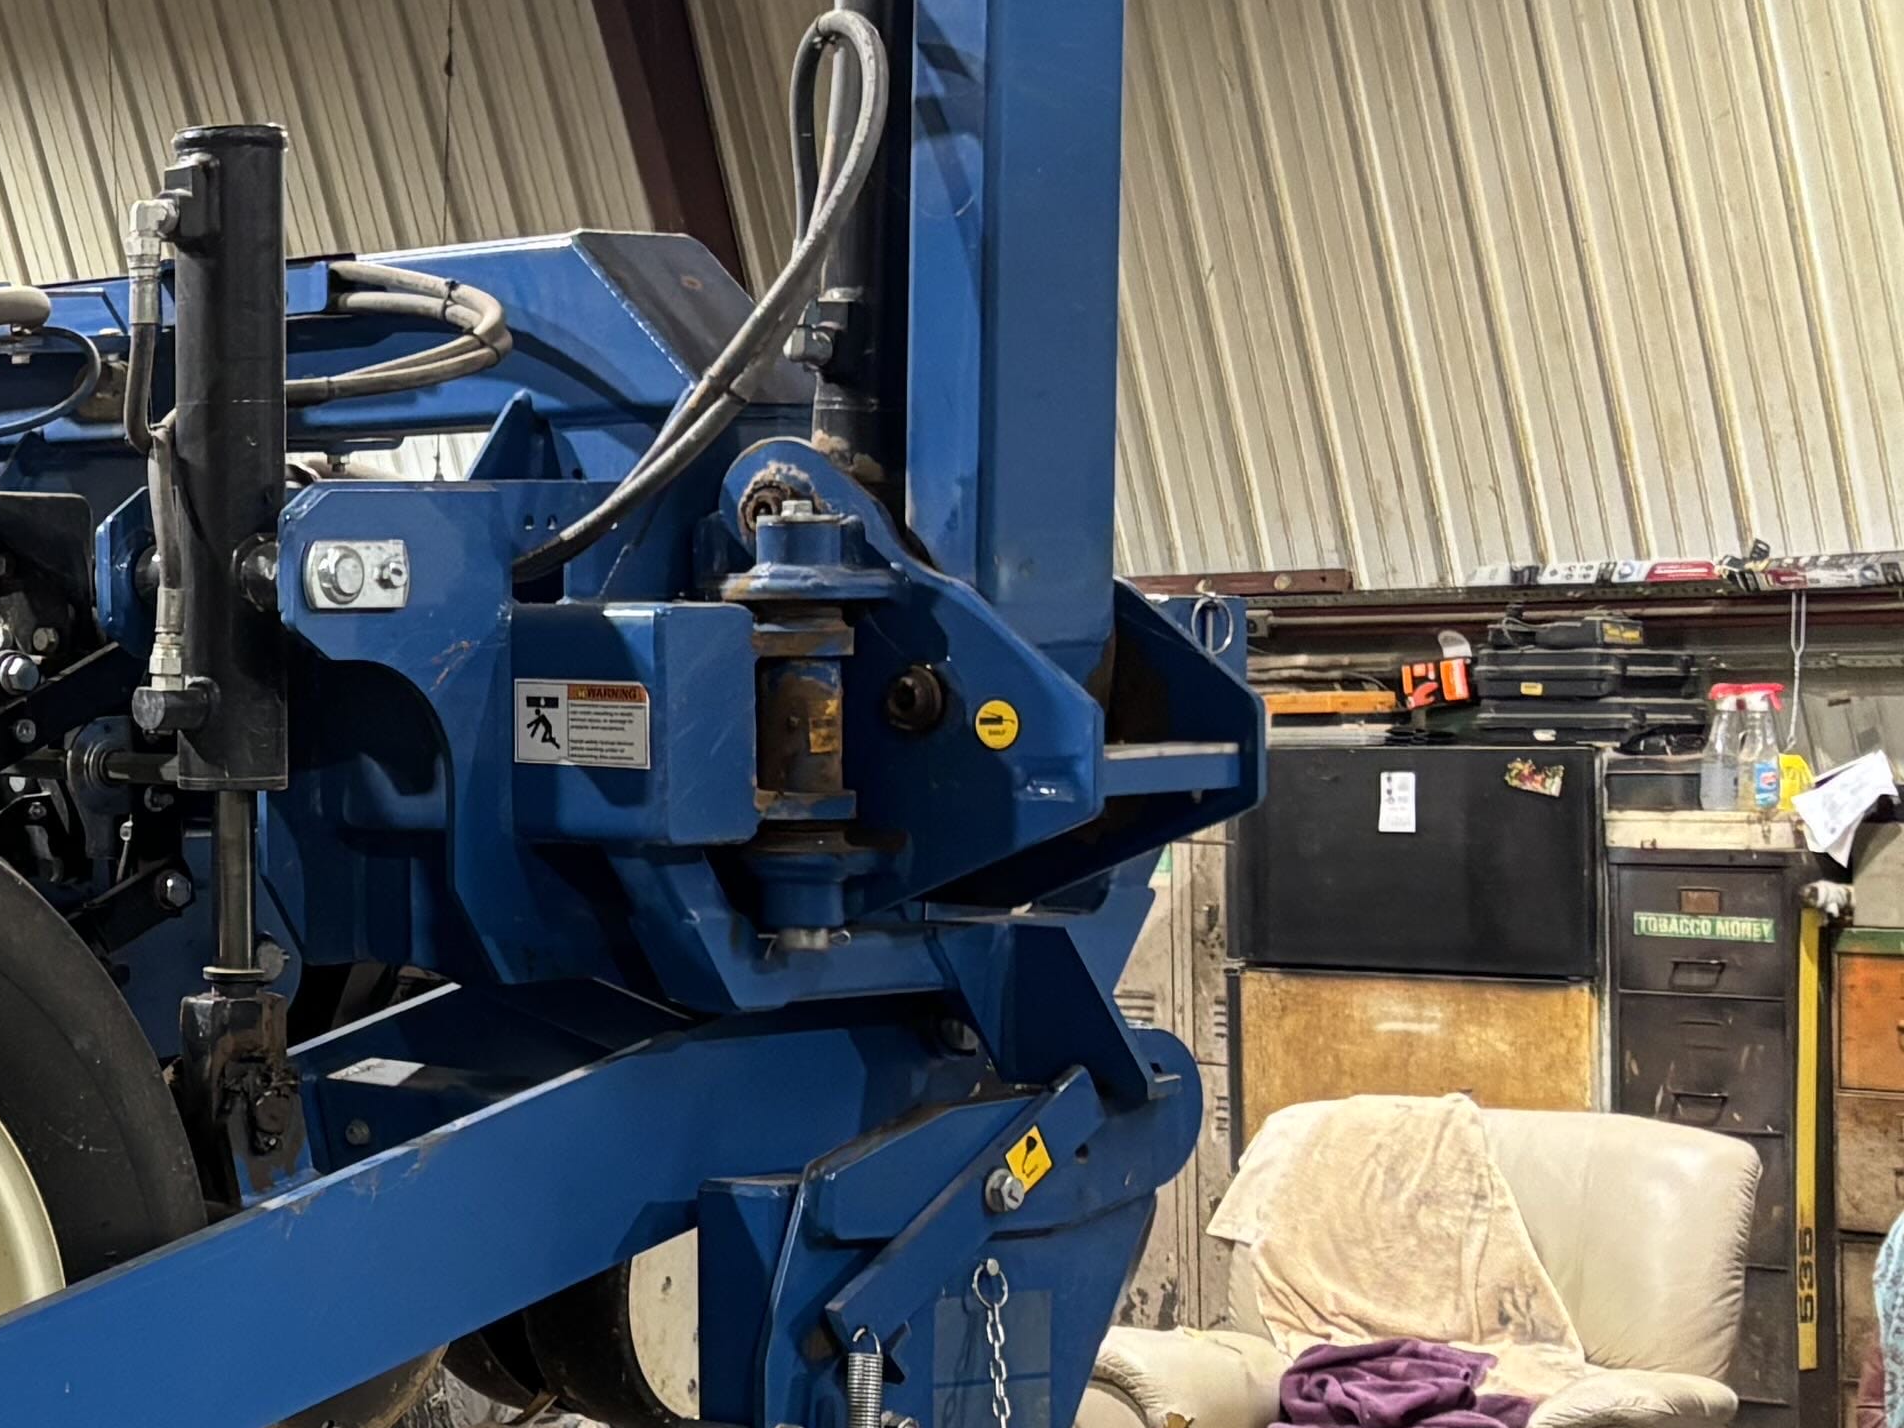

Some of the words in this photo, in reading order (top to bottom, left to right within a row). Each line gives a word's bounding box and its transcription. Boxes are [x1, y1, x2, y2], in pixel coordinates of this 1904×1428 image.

[587, 687, 638, 700] WARNING
[1638, 915, 1712, 936] TOBACCO
[1715, 919, 1774, 940] MONEY
